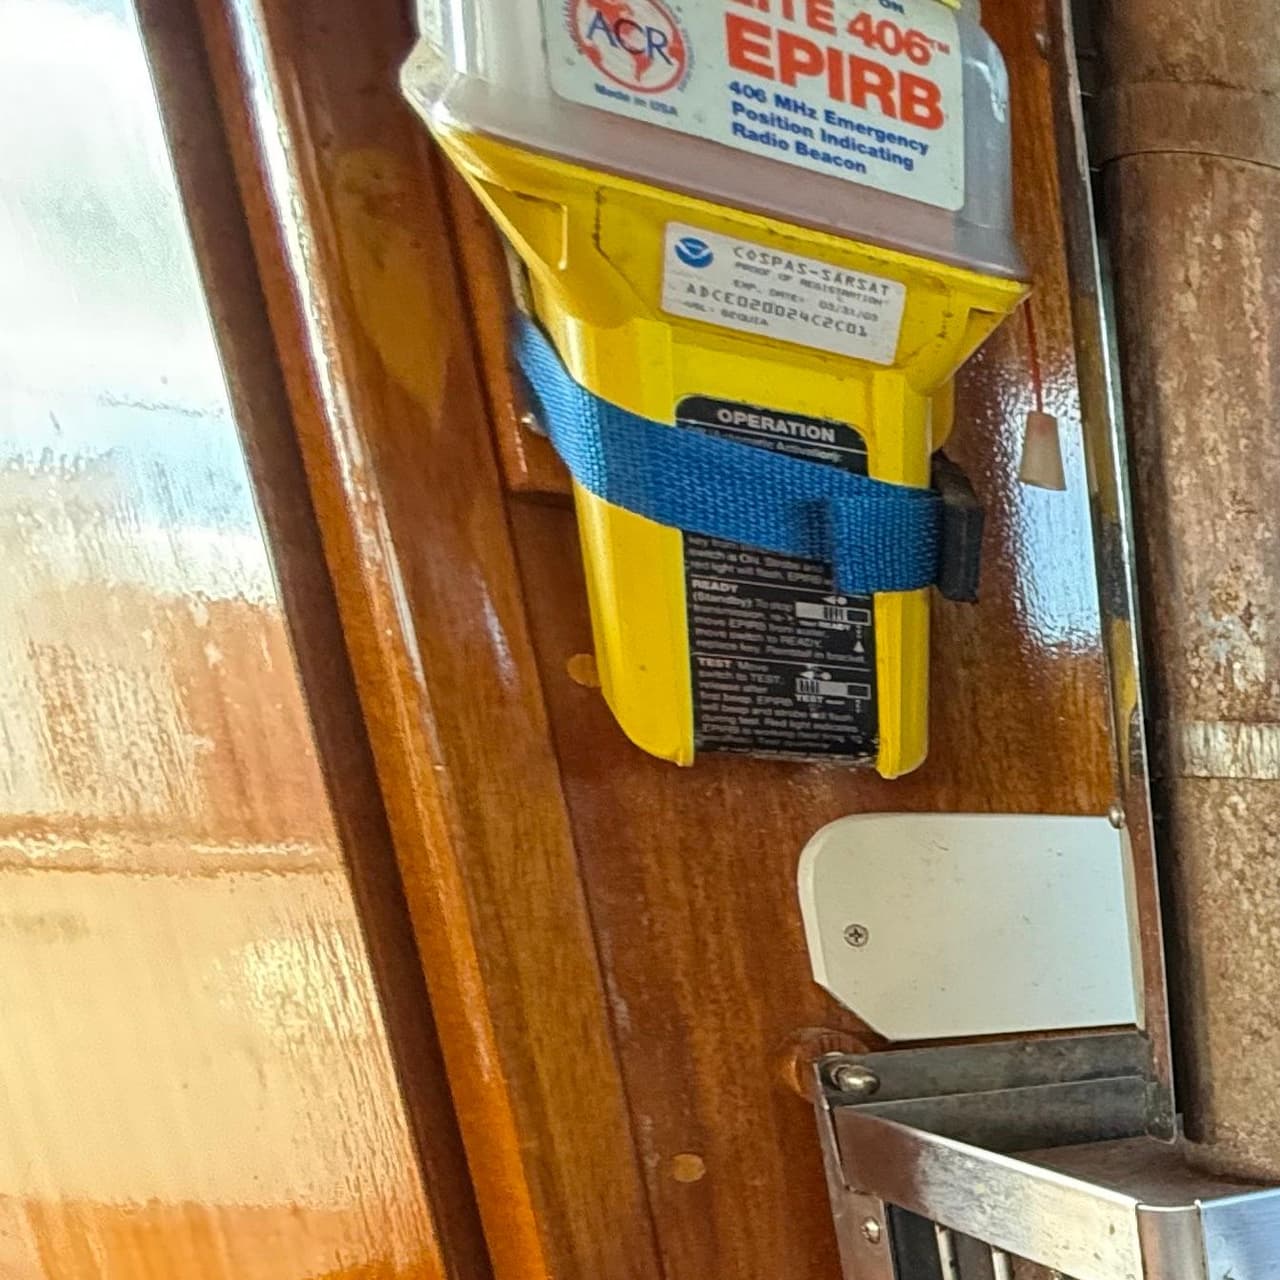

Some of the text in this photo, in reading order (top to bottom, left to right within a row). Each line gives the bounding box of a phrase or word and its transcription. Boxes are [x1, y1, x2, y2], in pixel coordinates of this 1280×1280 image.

[586, 11, 674, 66] ACR
[725, 12, 945, 131] EPIRB
[649, 99, 679, 118] USA
[729, 81, 929, 156] 406 MHz Emergency
[731, 101, 914, 171] Position Indicating
[731, 122, 867, 175] Radio Beacon
[733, 245, 890, 297] COSPAS-SARSAT
[717, 408, 836, 444] OPERATION
[692, 579, 739, 593] READY
[698, 657, 733, 669] TEST
